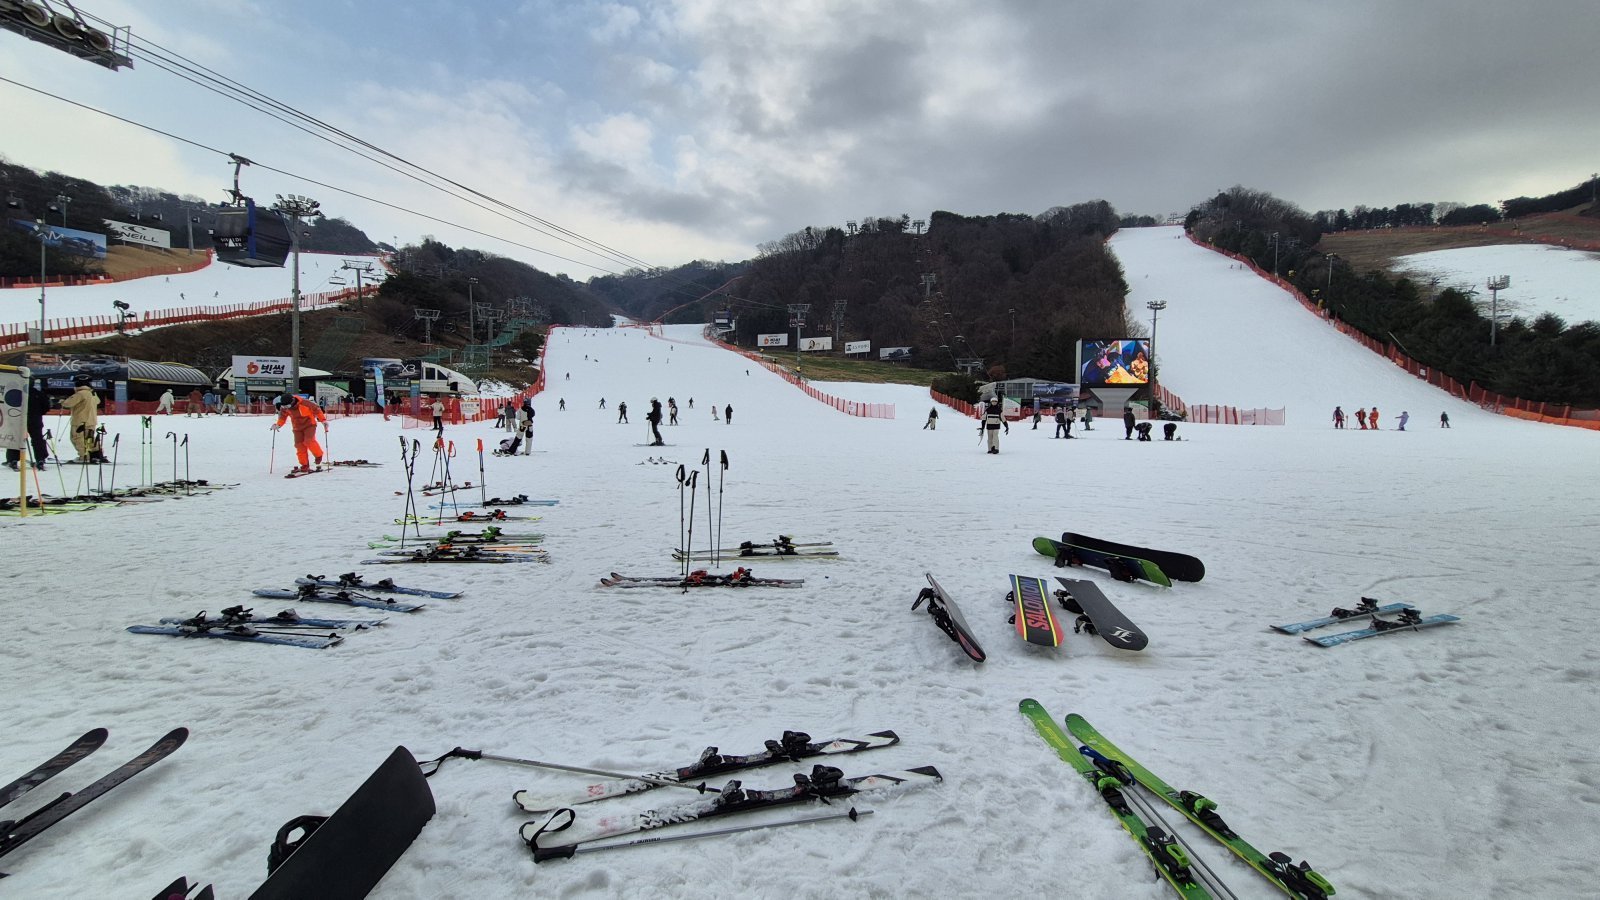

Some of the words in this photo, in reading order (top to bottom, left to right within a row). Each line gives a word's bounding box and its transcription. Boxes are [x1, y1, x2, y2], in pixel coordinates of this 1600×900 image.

[58, 358, 80, 371] X6
[260, 363, 286, 375] 빗썸
[400, 363, 416, 374] X3
[1019, 577, 1051, 631] SALOMON
